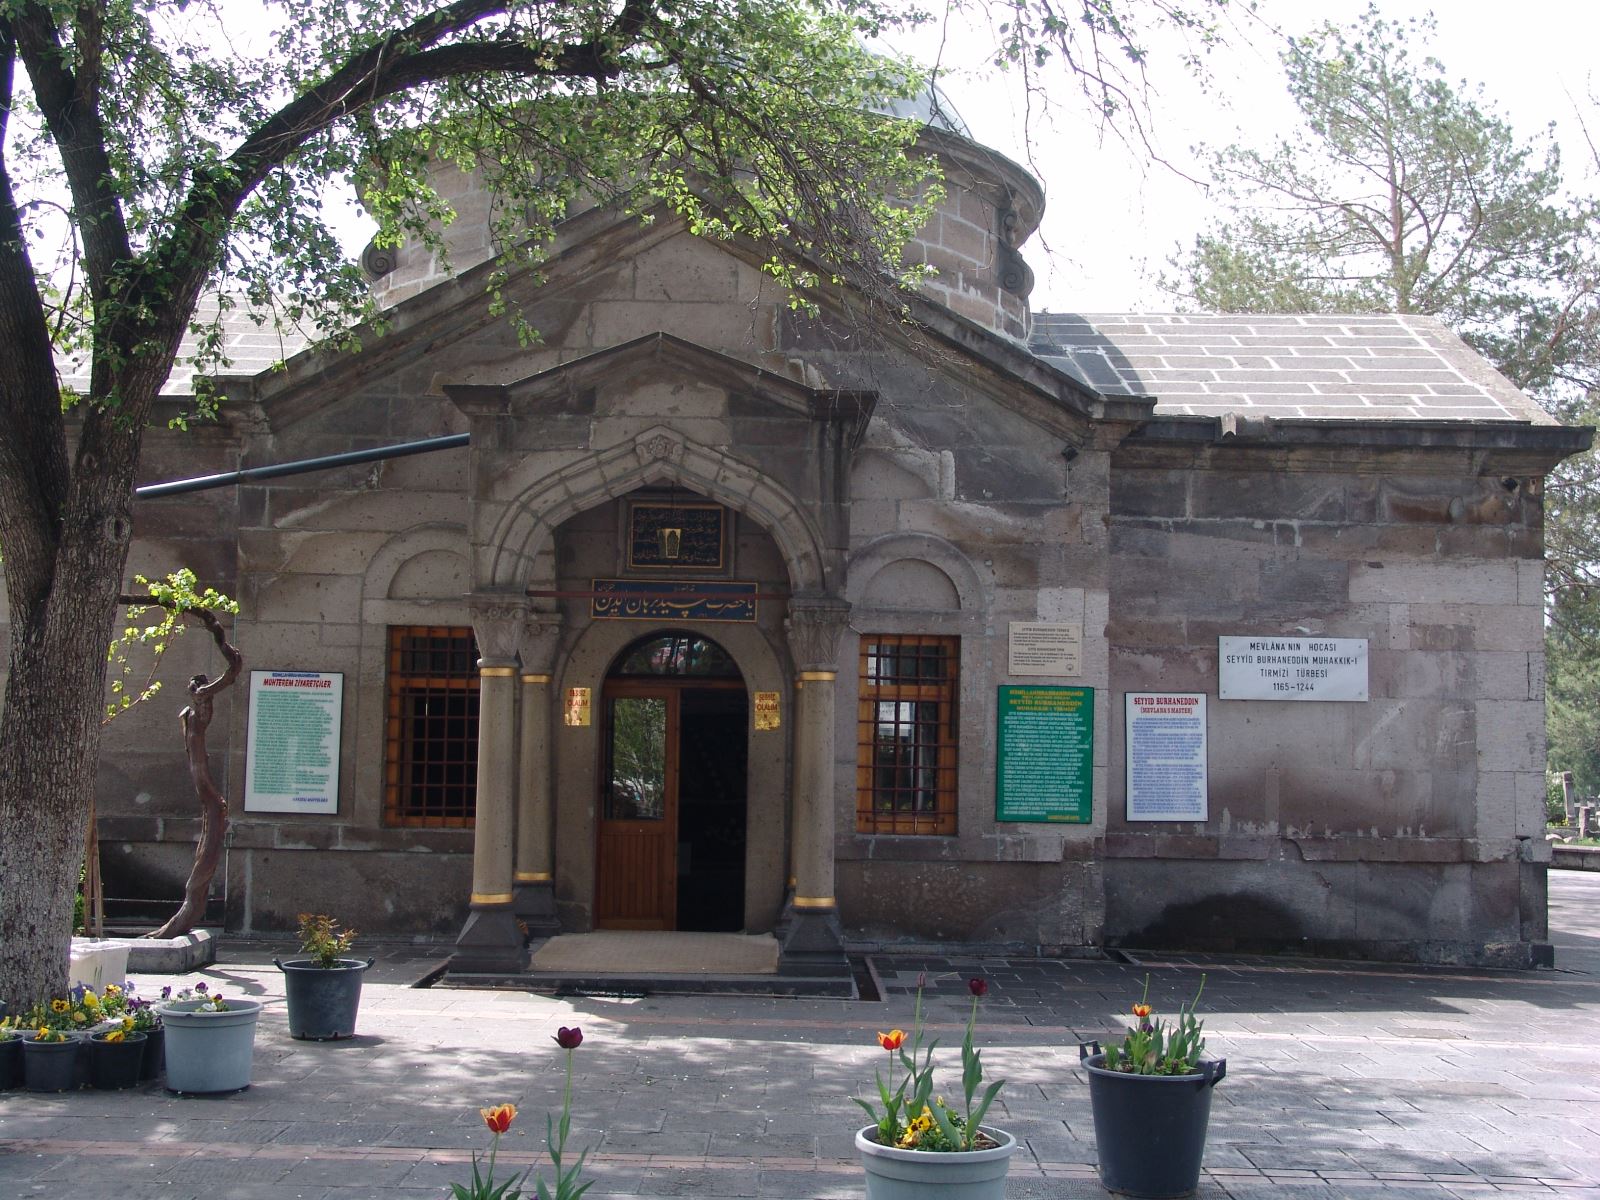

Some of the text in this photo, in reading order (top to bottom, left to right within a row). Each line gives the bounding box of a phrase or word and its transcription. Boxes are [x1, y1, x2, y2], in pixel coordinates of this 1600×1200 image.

[1309, 643, 1337, 651] HOCASI
[1226, 655, 1253, 664] SEYYİD
[1257, 655, 1309, 665] BURHANEDDİN
[1296, 669, 1328, 678] TÜRBESİ
[263, 678, 293, 687] MUHTEREM
